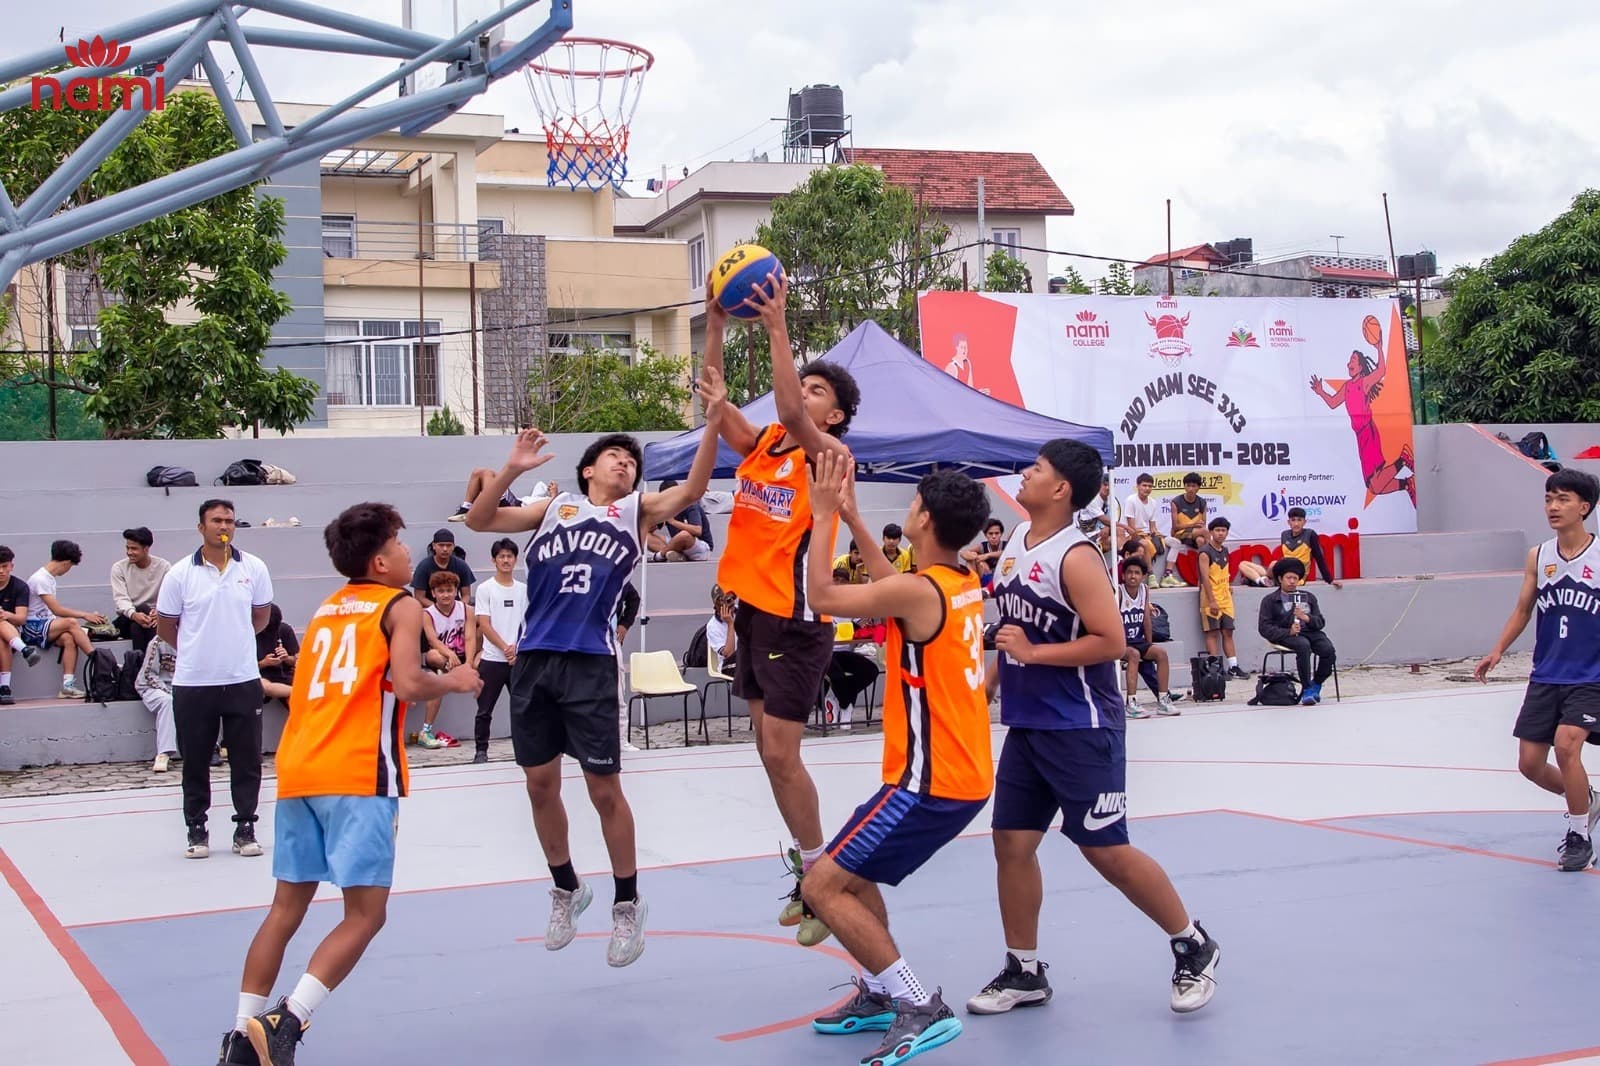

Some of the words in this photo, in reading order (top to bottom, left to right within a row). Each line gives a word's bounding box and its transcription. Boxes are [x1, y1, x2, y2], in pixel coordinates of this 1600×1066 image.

[1156, 300, 1178, 309] nami
[1066, 320, 1110, 338] nami
[1269, 325, 1293, 336] nami
[1073, 339, 1105, 347] COLLEGE
[1120, 396, 1146, 441] 2ND
[1144, 372, 1184, 408] NAMI
[1187, 373, 1217, 405] SEE
[1217, 392, 1247, 434] 3X3
[1237, 442, 1290, 466] 2082
[1277, 474, 1307, 482] Learning
[1308, 473, 1335, 481] Partner:
[1288, 495, 1347, 506] BROADWAY
[538, 530, 629, 566] NAVODIT
[560, 563, 592, 594] 23
[1537, 588, 1600, 615] NAVODIT
[1559, 615, 1568, 639] 6
[308, 623, 358, 701] 24
